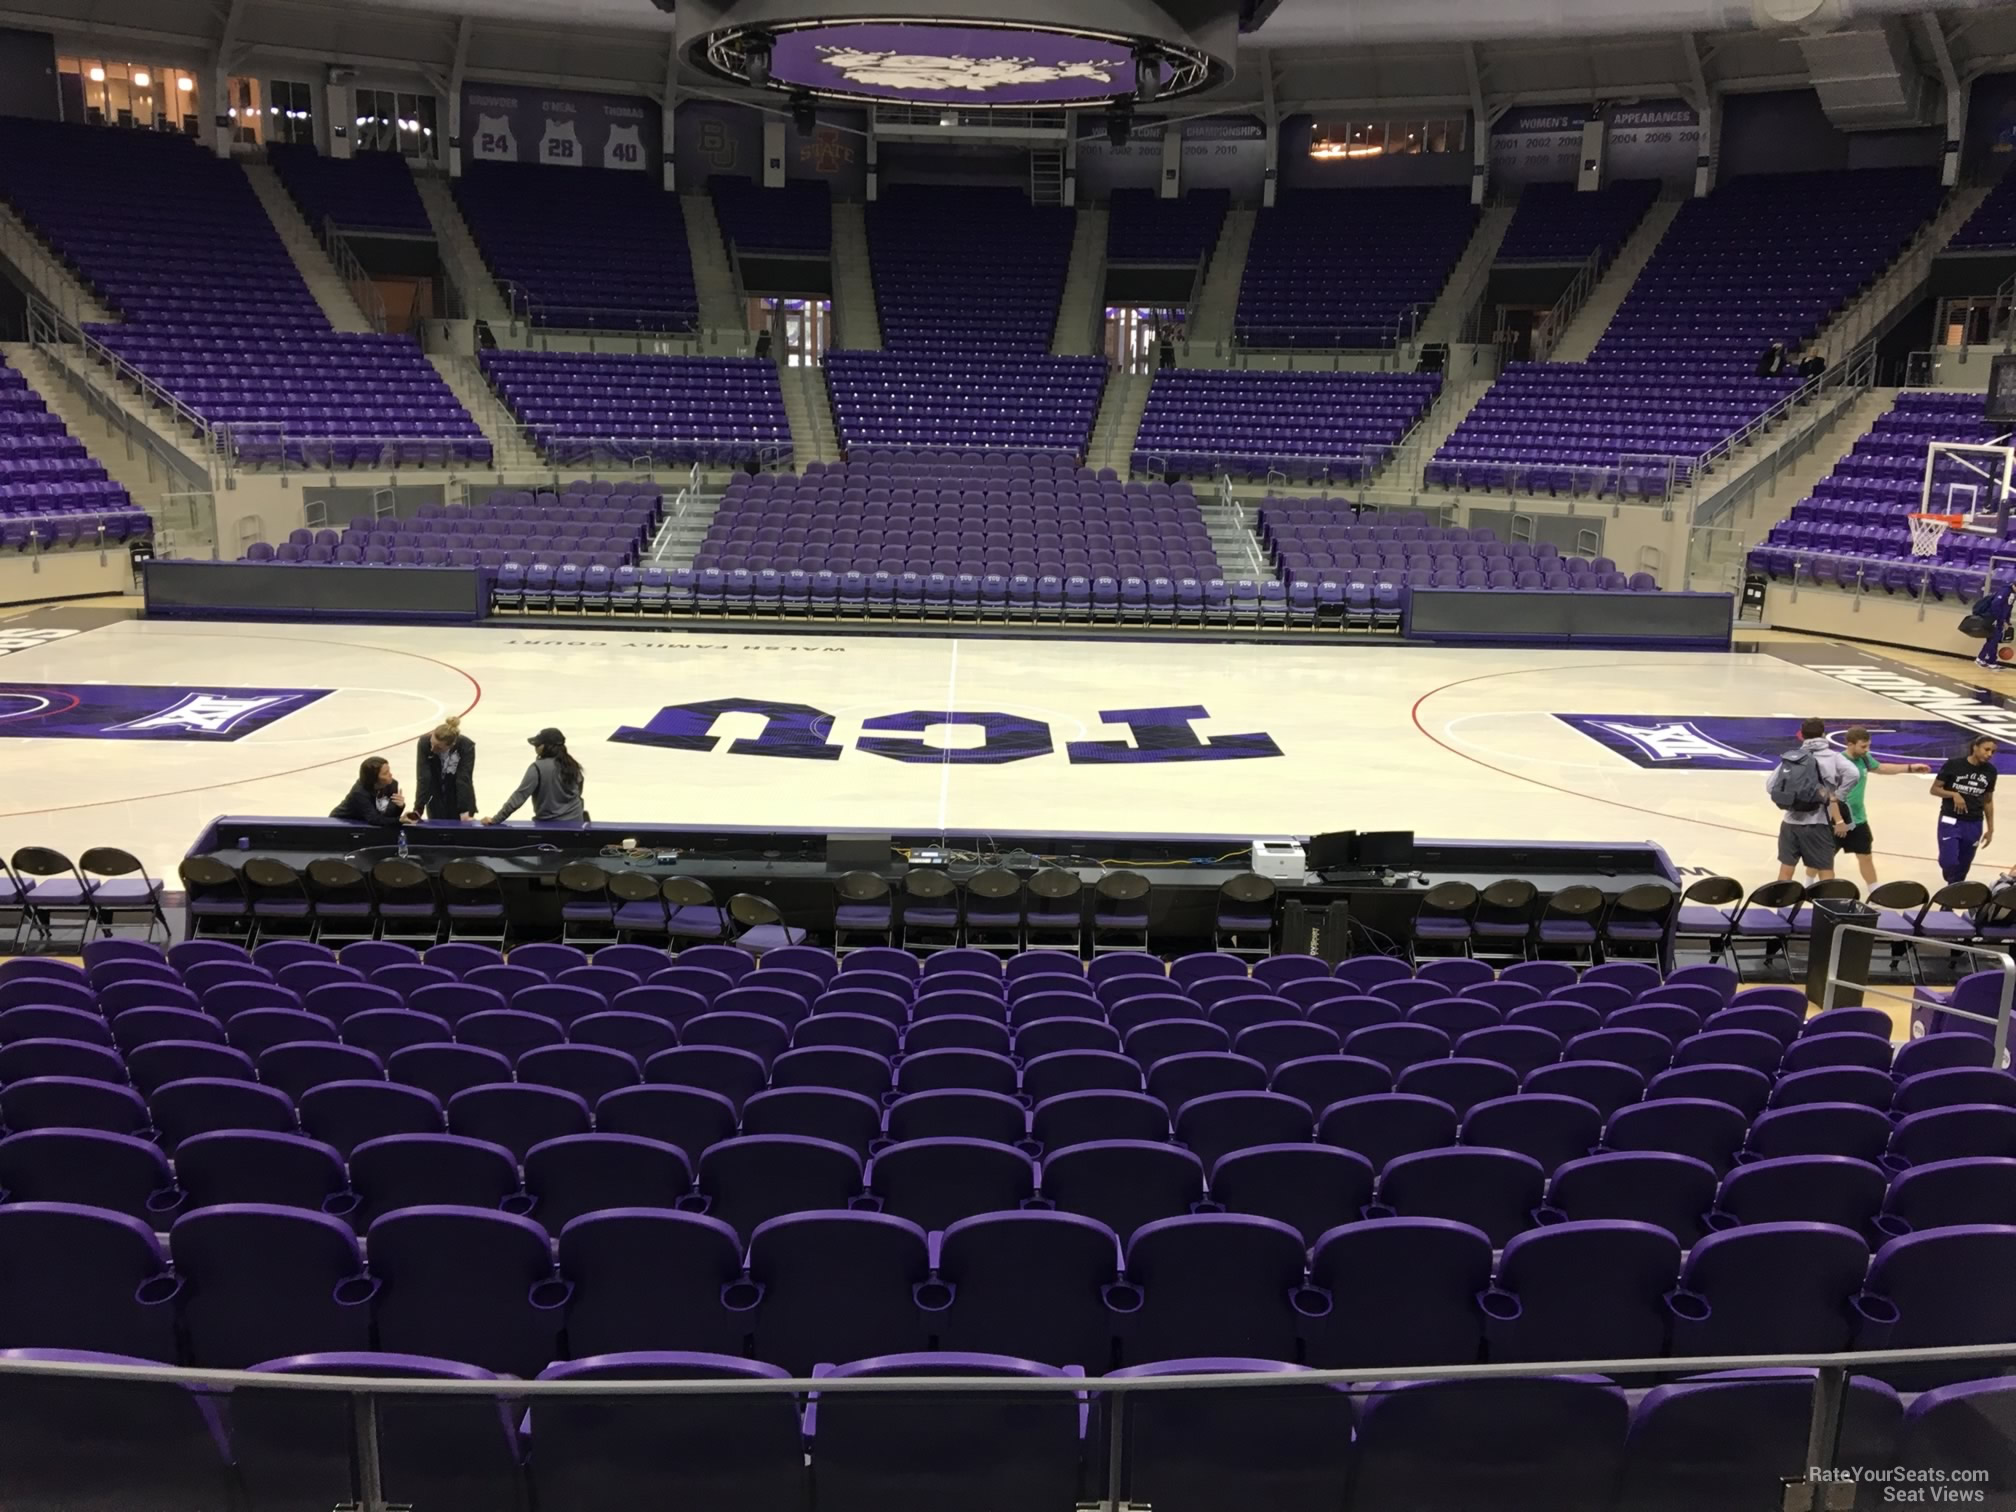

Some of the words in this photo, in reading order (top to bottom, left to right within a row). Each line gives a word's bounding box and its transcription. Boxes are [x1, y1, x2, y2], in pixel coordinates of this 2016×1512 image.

[603, 105, 644, 118] THOMAS
[1614, 111, 1690, 124] APPEARANCES
[1519, 116, 1569, 129] WOMEN'S
[1186, 126, 1262, 137] CHAMPIONSHIPS
[481, 133, 508, 153] 24
[1495, 139, 1518, 150] 2001
[1526, 138, 1551, 148] 2002
[1611, 134, 1637, 144] 2004
[548, 138, 573, 158] 28
[612, 143, 638, 162] 40
[800, 143, 854, 164] STATE
[1214, 145, 1238, 155] 2010
[504, 639, 608, 647] COURT
[608, 698, 1285, 765] TCU
